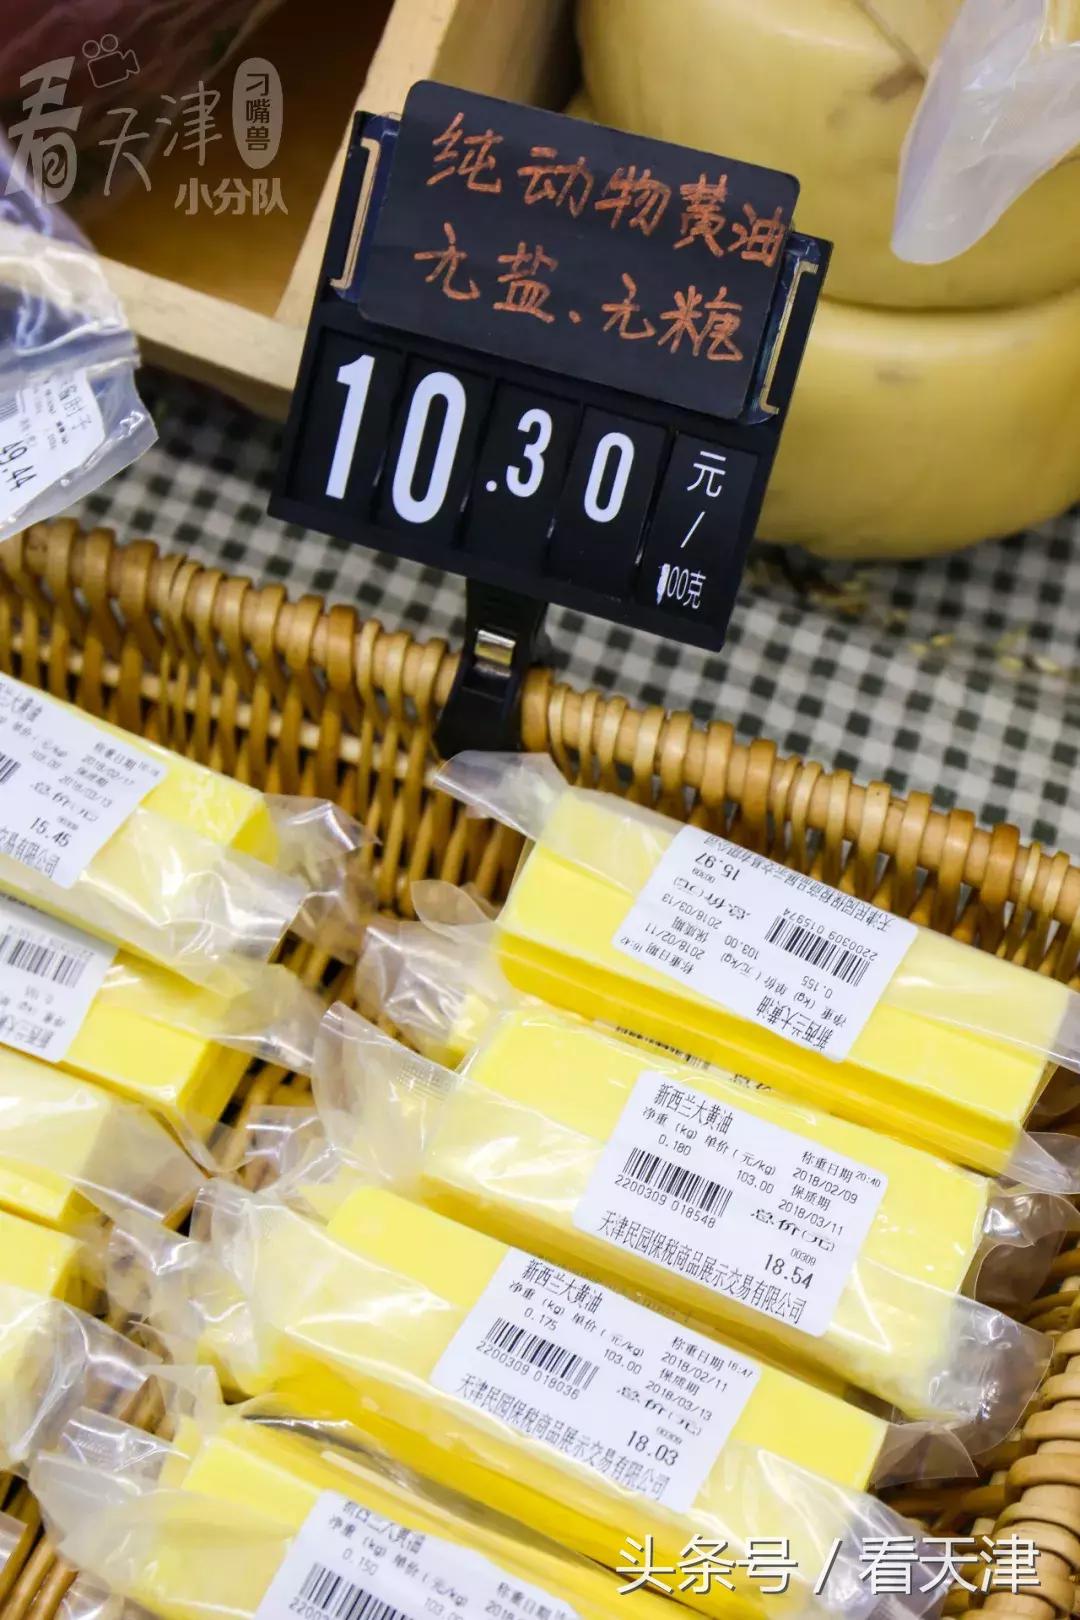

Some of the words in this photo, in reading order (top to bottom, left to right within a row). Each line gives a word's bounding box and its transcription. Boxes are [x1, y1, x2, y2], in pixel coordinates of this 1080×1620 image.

[427, 112, 786, 267] 纯动物黄油
[686, 451, 727, 498] 元
[30, 817, 71, 847] 15.45
[695, 852, 740, 881] 15.97
[661, 893, 722, 929] 2018/03/13
[779, 907, 825, 934] 015974
[645, 922, 705, 960] 2018/02/11
[671, 916, 710, 944] 保质期
[828, 931, 878, 961] 2200309
[645, 942, 694, 974] 称重日期
[724, 935, 759, 960] 103.00
[801, 976, 833, 1000] 0.155
[756, 995, 834, 1052] 新西兰大黄油
[820, 1006, 847, 1028] 净重
[643, 1106, 669, 1127] 净重
[654, 1082, 733, 1135] 新西兰大黄油
[656, 1134, 691, 1156] 0.180
[737, 1169, 774, 1194] 103.00
[792, 1167, 858, 1204] 2018/02/09
[801, 1151, 853, 1183] 称重日期
[855, 1171, 881, 1187] 20:40
[614, 1174, 668, 1205] 2200309
[670, 1200, 716, 1228] 018548
[790, 1184, 831, 1211] 保质期
[778, 1199, 843, 1236] 2018/03/11
[597, 1210, 807, 1324] 天津民园保税商品展示交易有限公司
[765, 1254, 813, 1289] 18.54
[790, 1248, 816, 1266] 00309
[509, 1280, 535, 1300] 净重
[522, 1259, 603, 1315] 新西兰大黄油
[524, 1307, 559, 1331] 0.175
[476, 1340, 533, 1375] 2200309
[604, 1348, 642, 1375] 103.00
[672, 1336, 725, 1371] 称重日期
[661, 1352, 727, 1392] 2018/02/11
[645, 1380, 712, 1421] 2018/03/13
[627, 1430, 679, 1466] 18.03
[342, 1548, 379, 1576] 0.150
